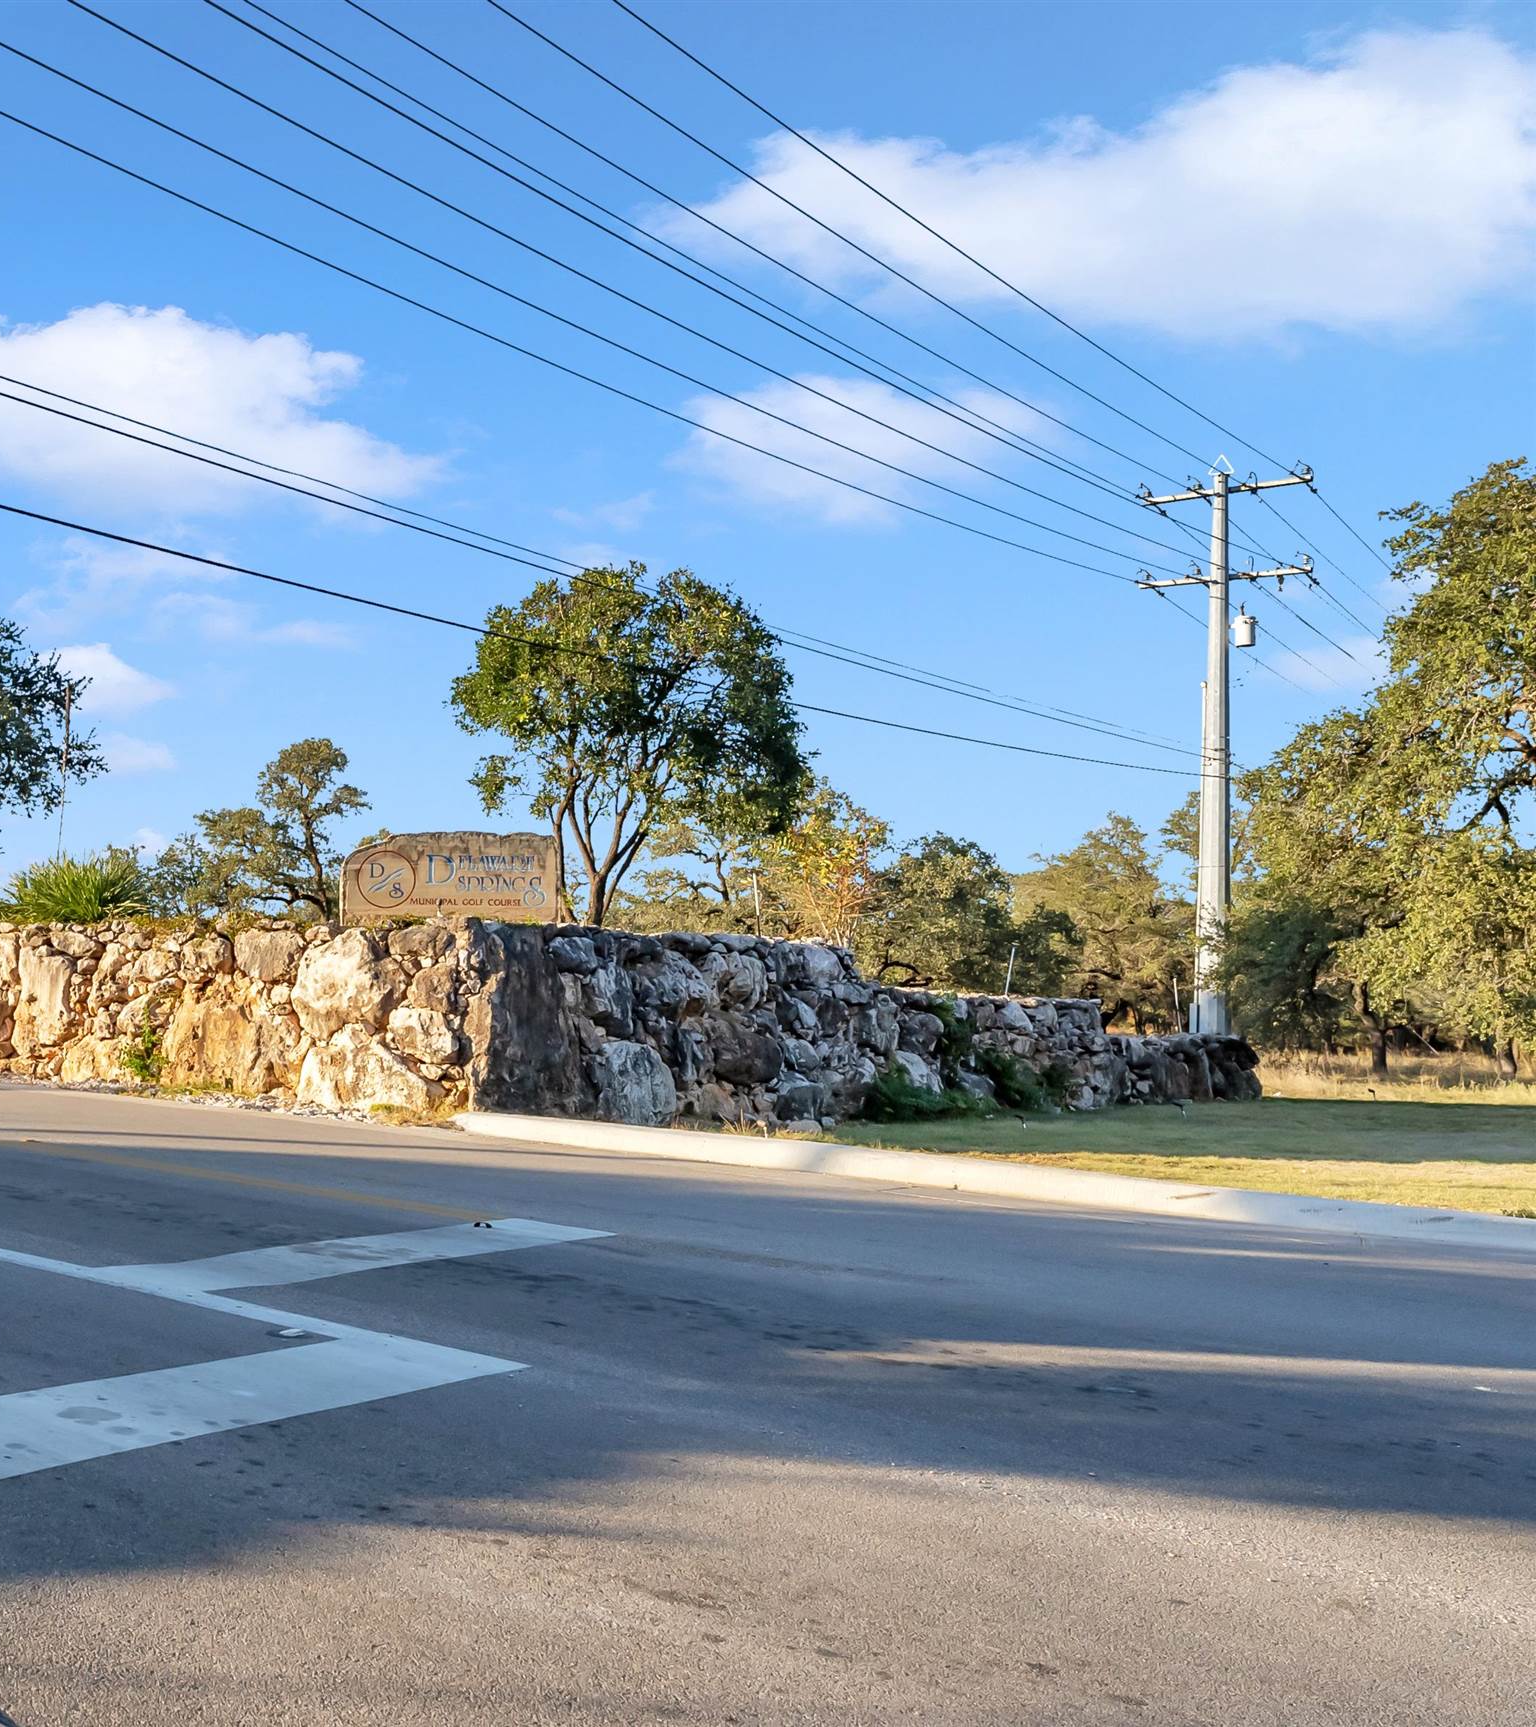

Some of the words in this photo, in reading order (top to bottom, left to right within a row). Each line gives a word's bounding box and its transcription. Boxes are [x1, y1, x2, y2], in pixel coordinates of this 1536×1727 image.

[370, 863, 384, 878] D
[426, 854, 535, 884] DELAWARE
[389, 883, 404, 898] S
[457, 876, 546, 907] SPRINGS
